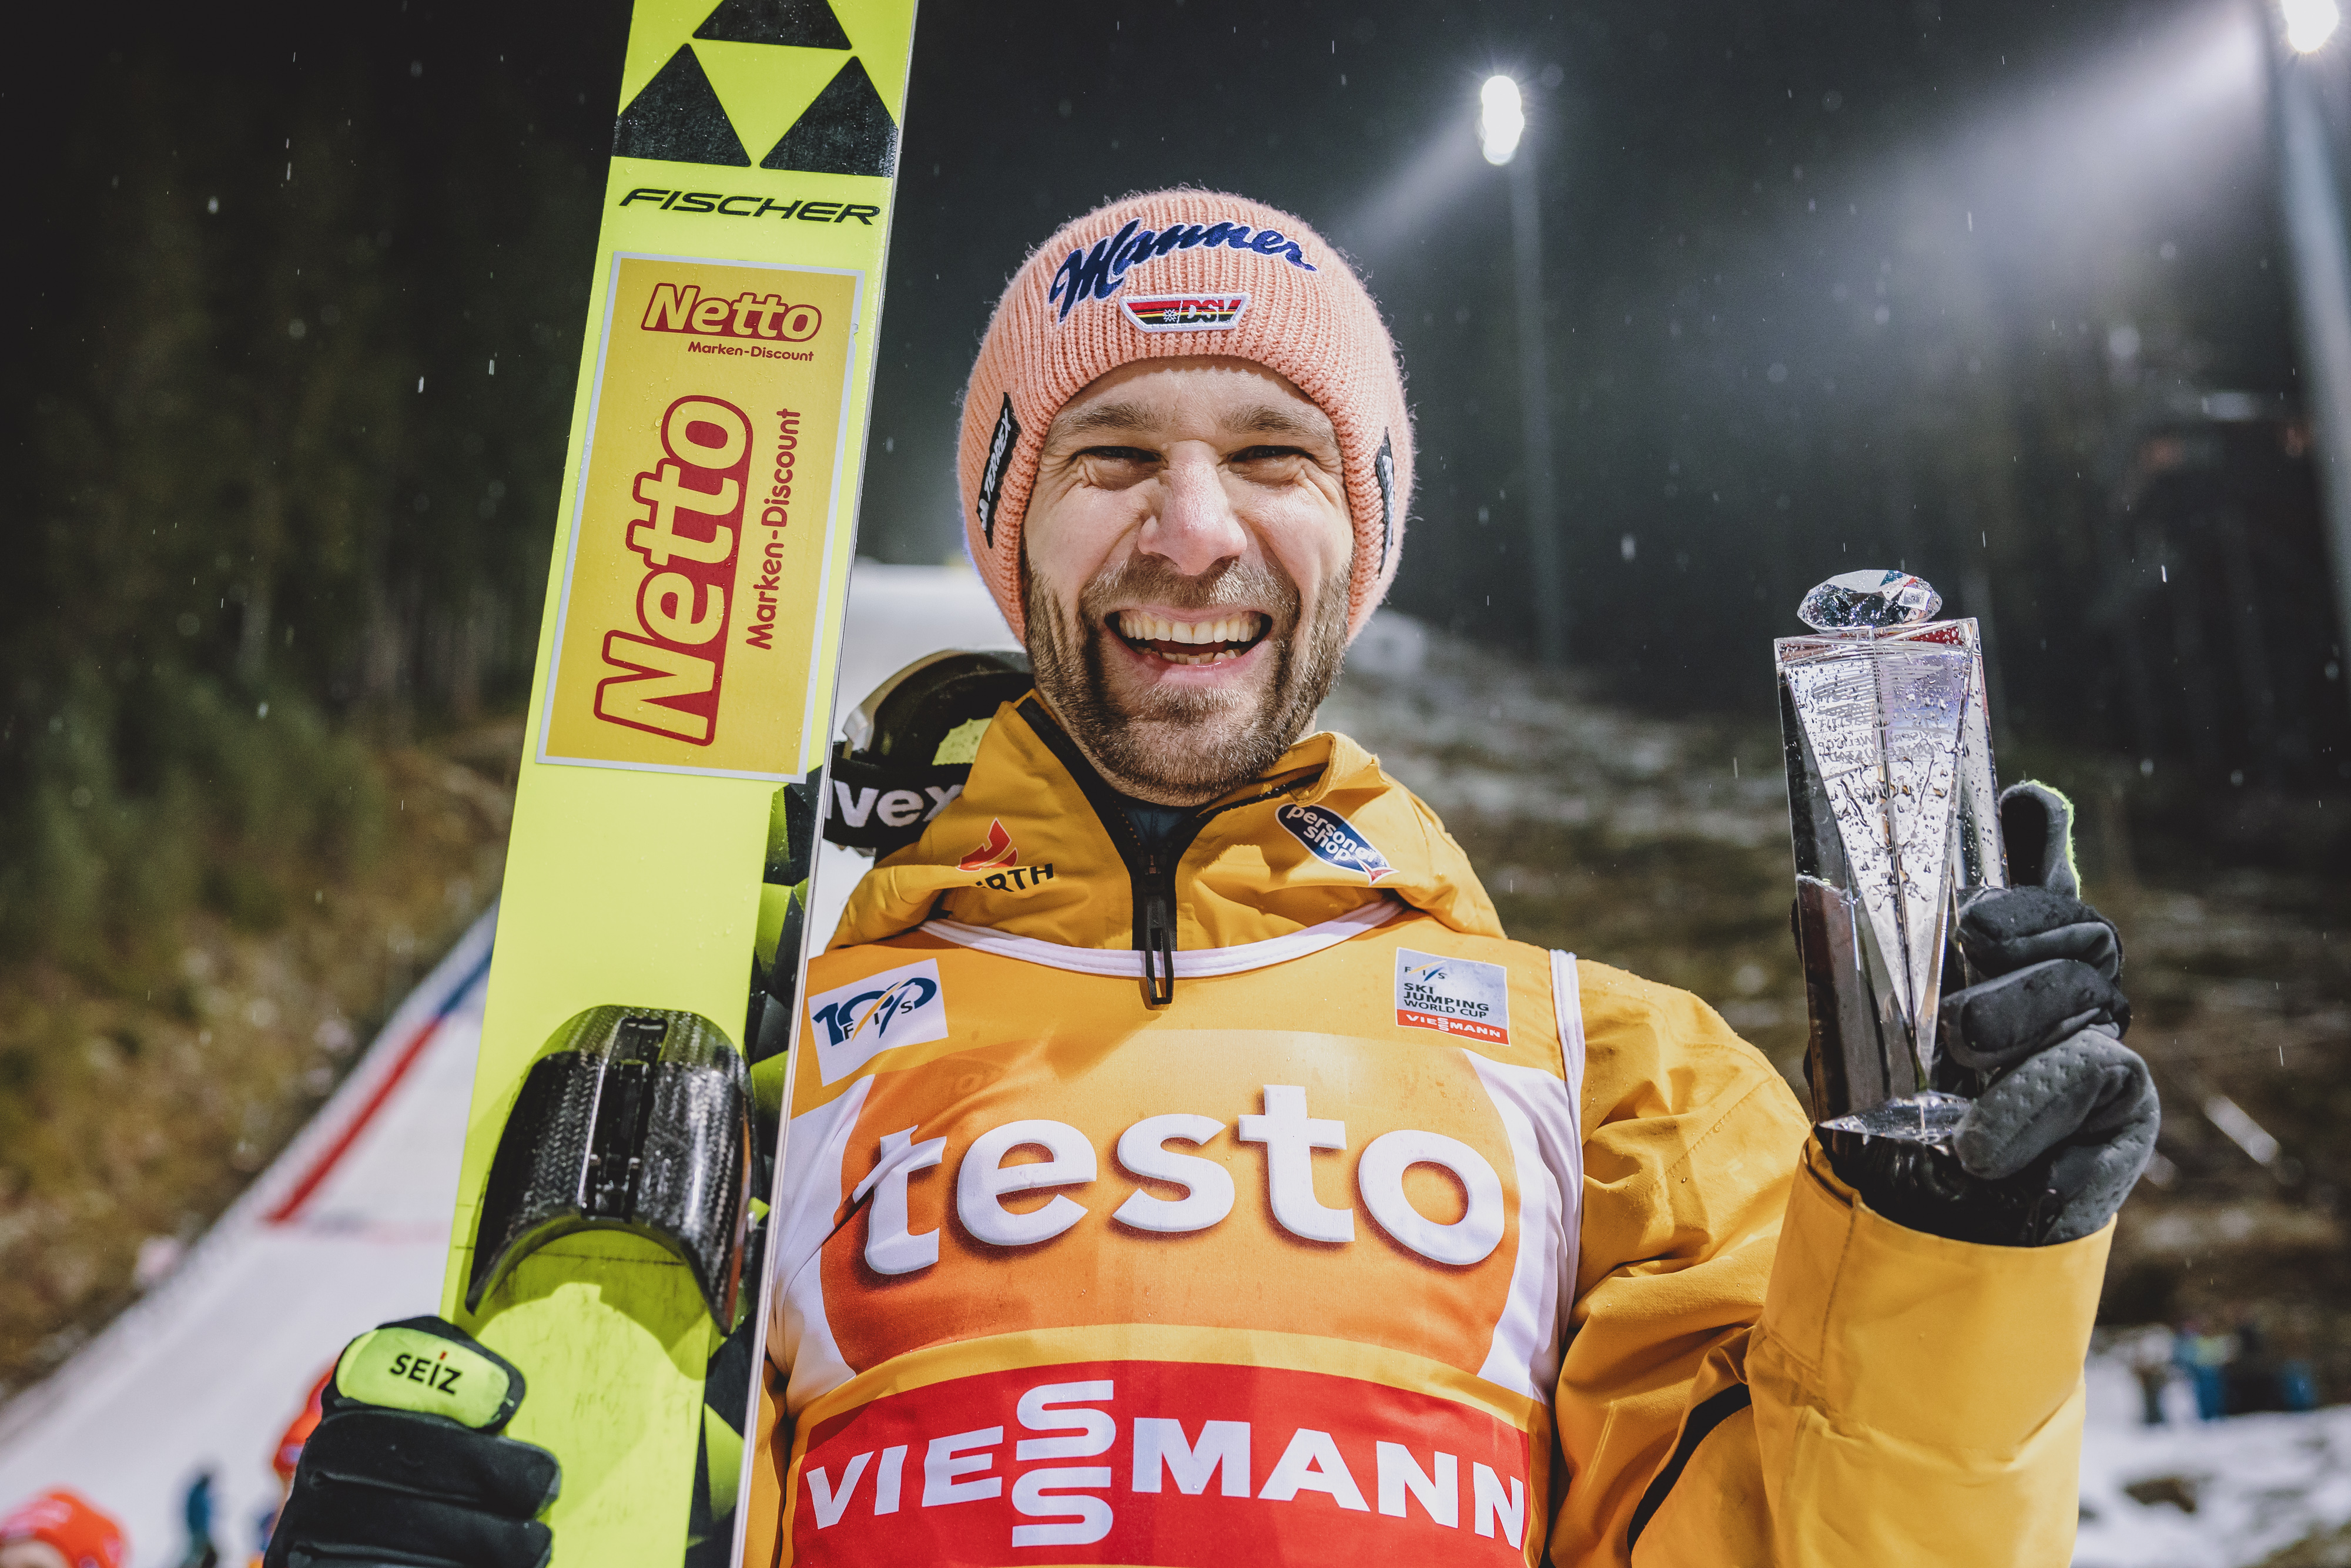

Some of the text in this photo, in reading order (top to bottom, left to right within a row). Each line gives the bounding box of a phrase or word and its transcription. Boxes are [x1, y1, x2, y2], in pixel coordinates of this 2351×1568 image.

[619, 187, 880, 225] FISCHER
[1049, 217, 1318, 325] Manner
[641, 283, 822, 342] Netto
[1180, 299, 1241, 323] DSV
[688, 341, 814, 361] Marken-Discount
[746, 408, 801, 651] Marken-Discount
[594, 394, 753, 746] Netto
[1303, 825, 1351, 862] shop
[975, 863, 1054, 893] RTH
[1404, 983, 1434, 994] SKI
[1404, 991, 1489, 1011] JUMPING
[1404, 999, 1487, 1018] WORLD CUP
[1405, 1014, 1501, 1038] VIESSMANN
[853, 1084, 1506, 1276] testo
[806, 1379, 1525, 1552] VIESSMANN
